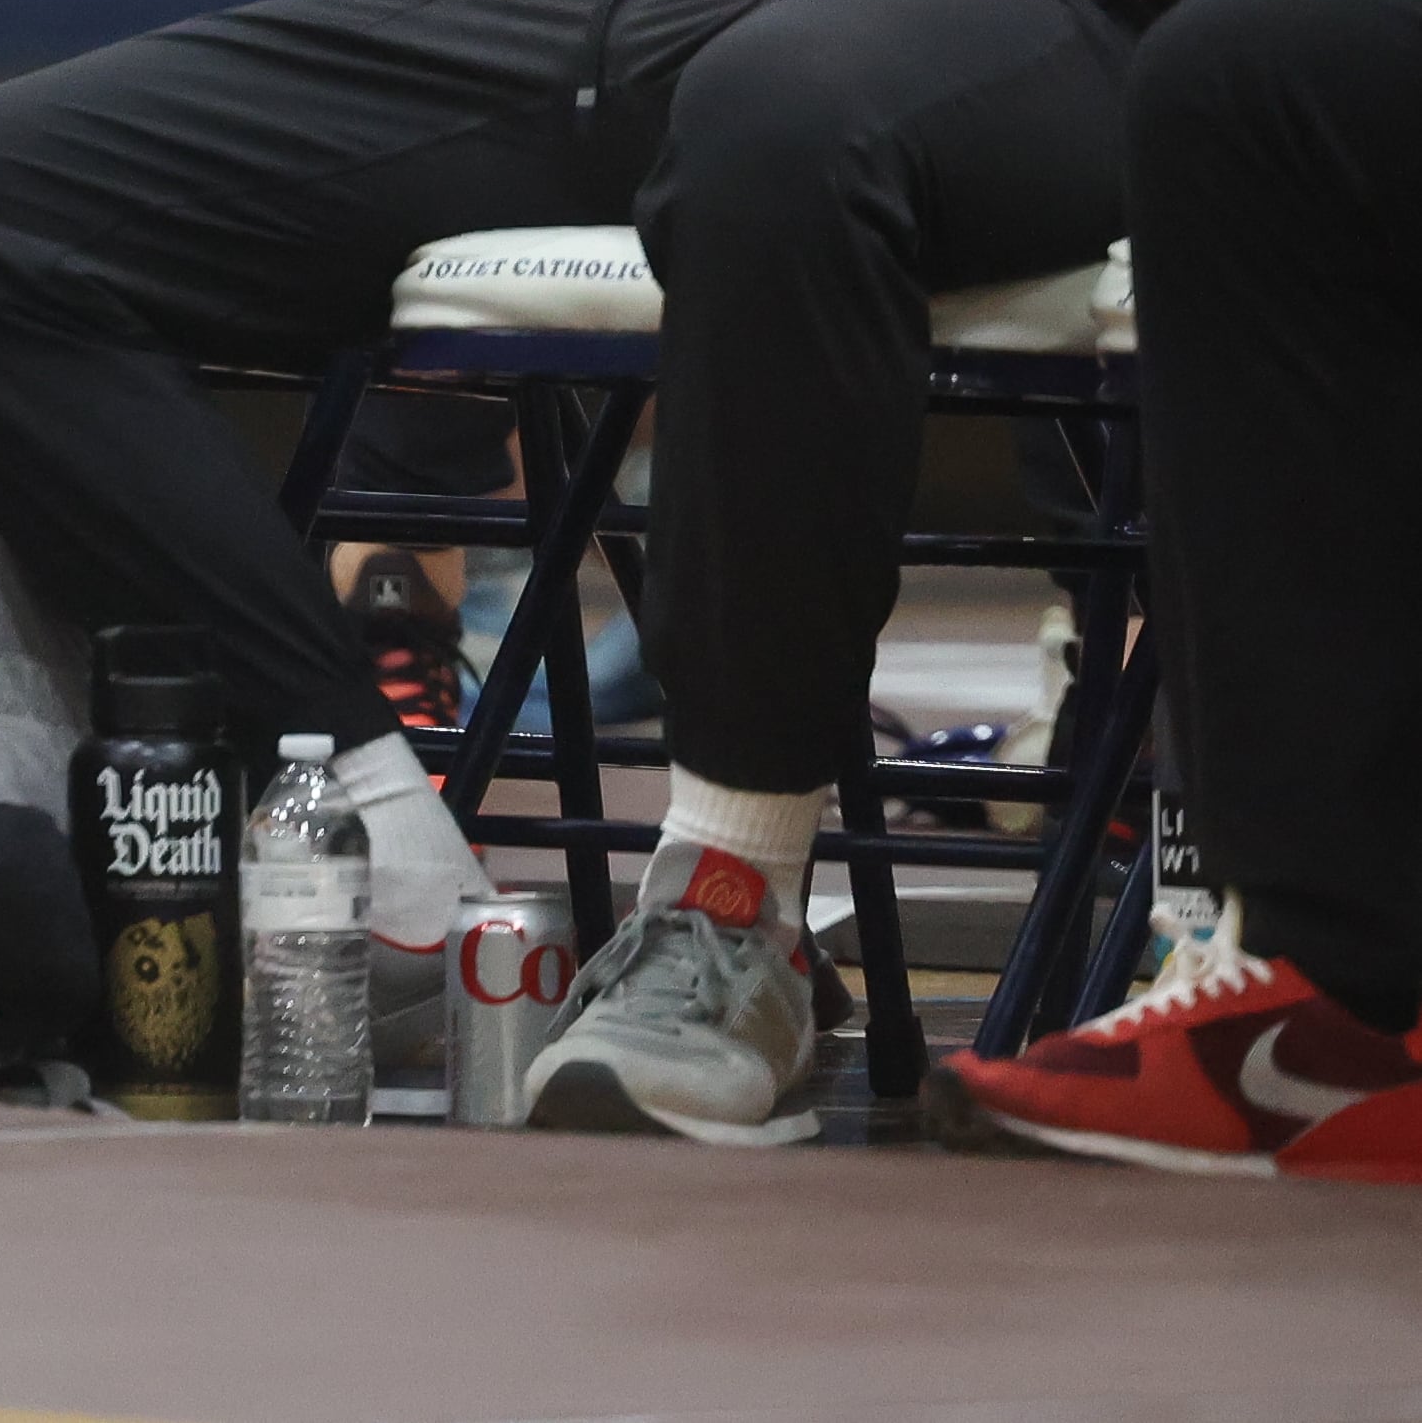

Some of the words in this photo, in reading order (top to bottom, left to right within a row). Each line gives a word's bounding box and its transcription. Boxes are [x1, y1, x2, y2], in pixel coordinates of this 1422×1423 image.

[418, 258, 509, 279] JOLIET
[511, 257, 650, 281] CATHOLIC
[96, 765, 222, 837] Liquid
[107, 821, 222, 877] Death
[460, 919, 575, 1006] Co
